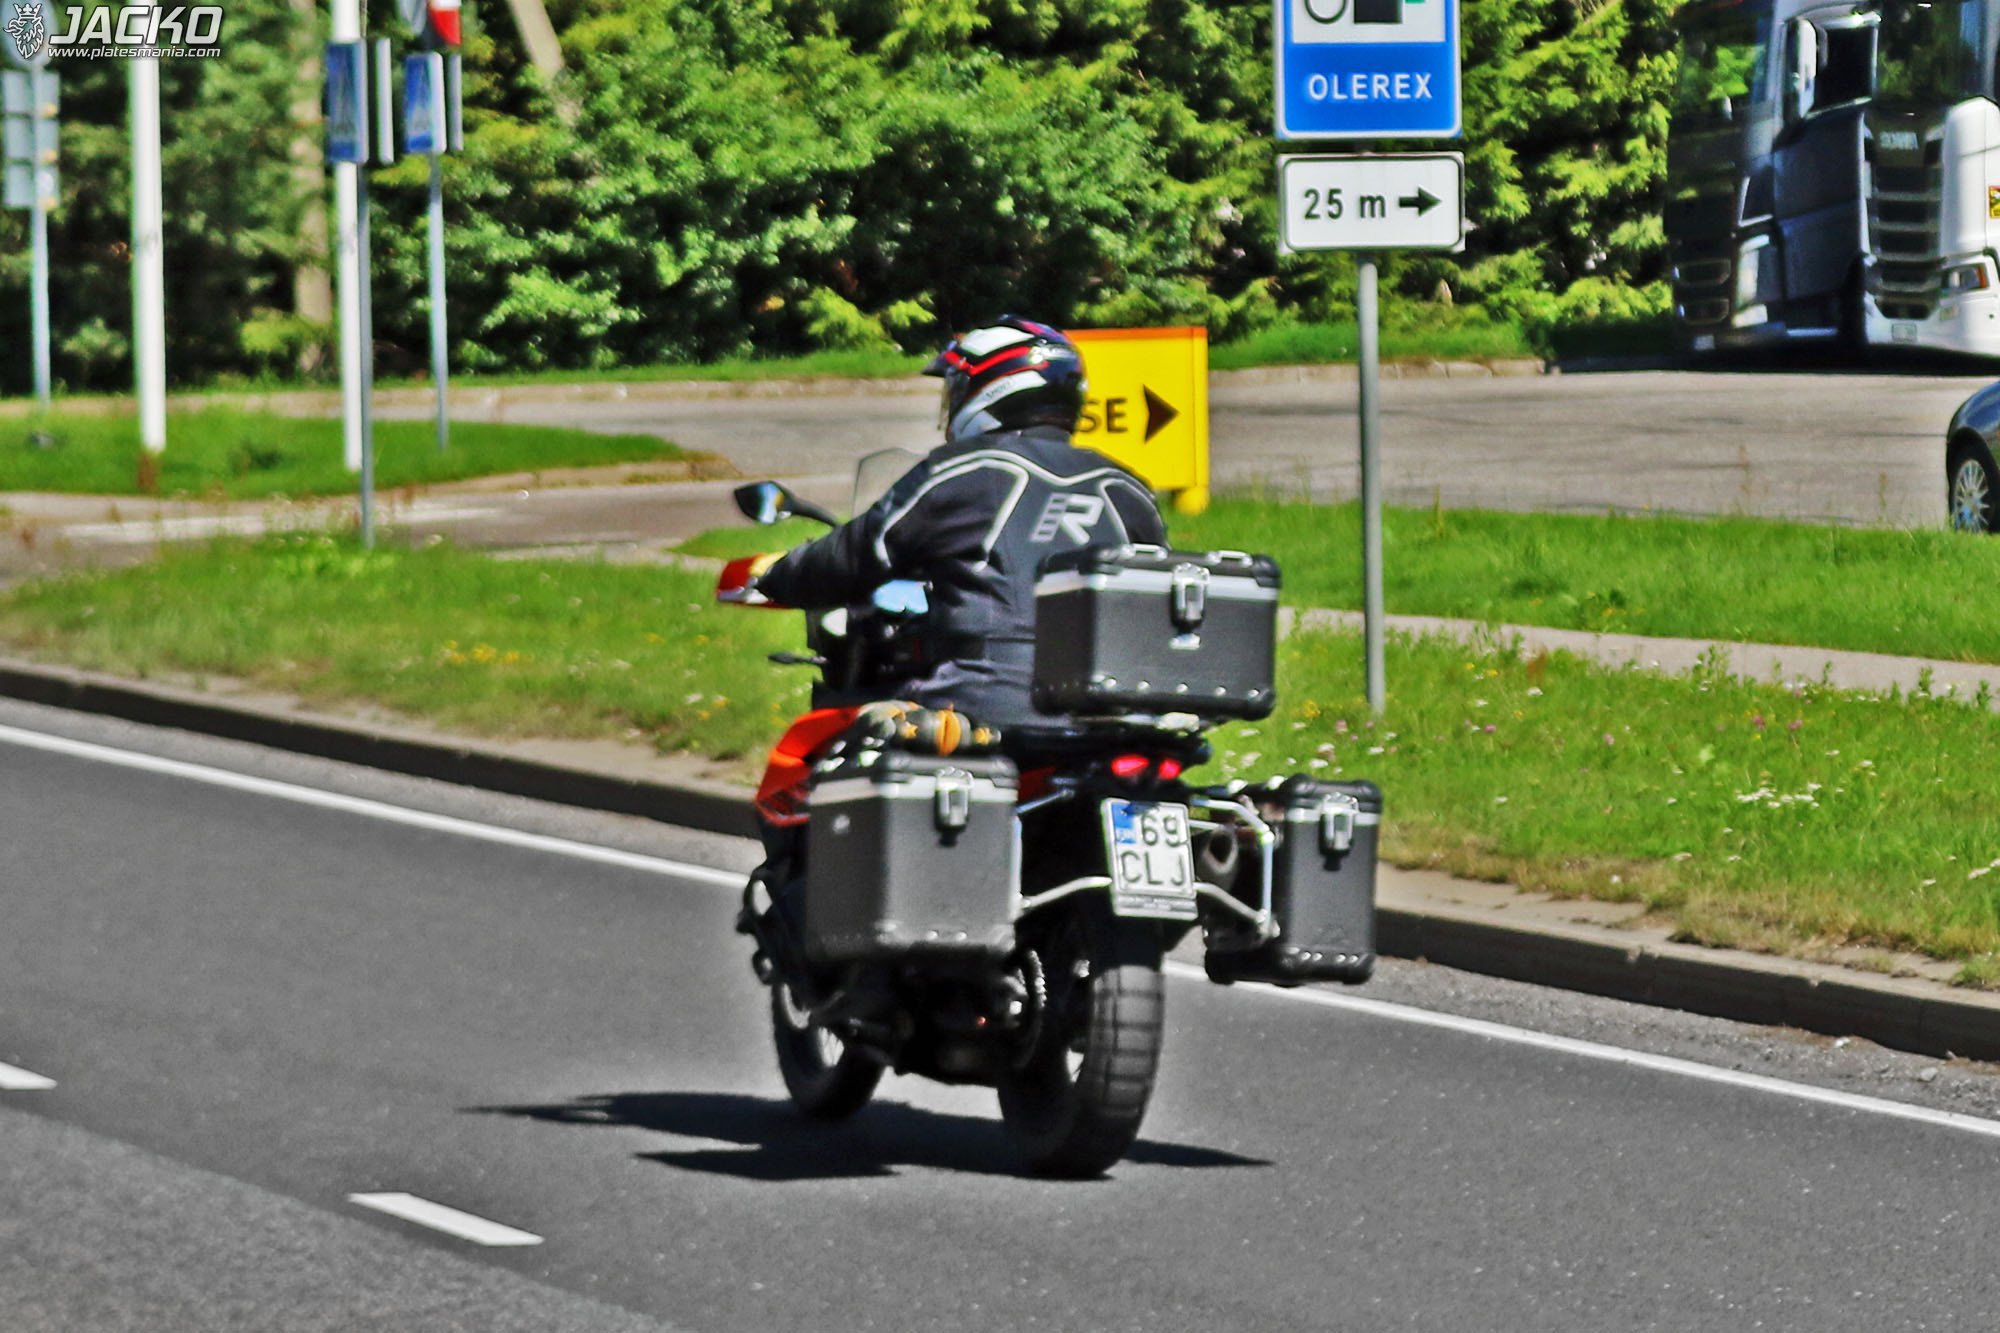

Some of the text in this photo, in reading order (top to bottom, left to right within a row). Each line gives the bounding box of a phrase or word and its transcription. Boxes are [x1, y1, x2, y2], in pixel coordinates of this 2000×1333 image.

[1308, 73, 1432, 100] OLEREX
[1304, 188, 1386, 220] 25 m
[1141, 811, 1181, 848] 69
[1121, 850, 1185, 887] CLJ
